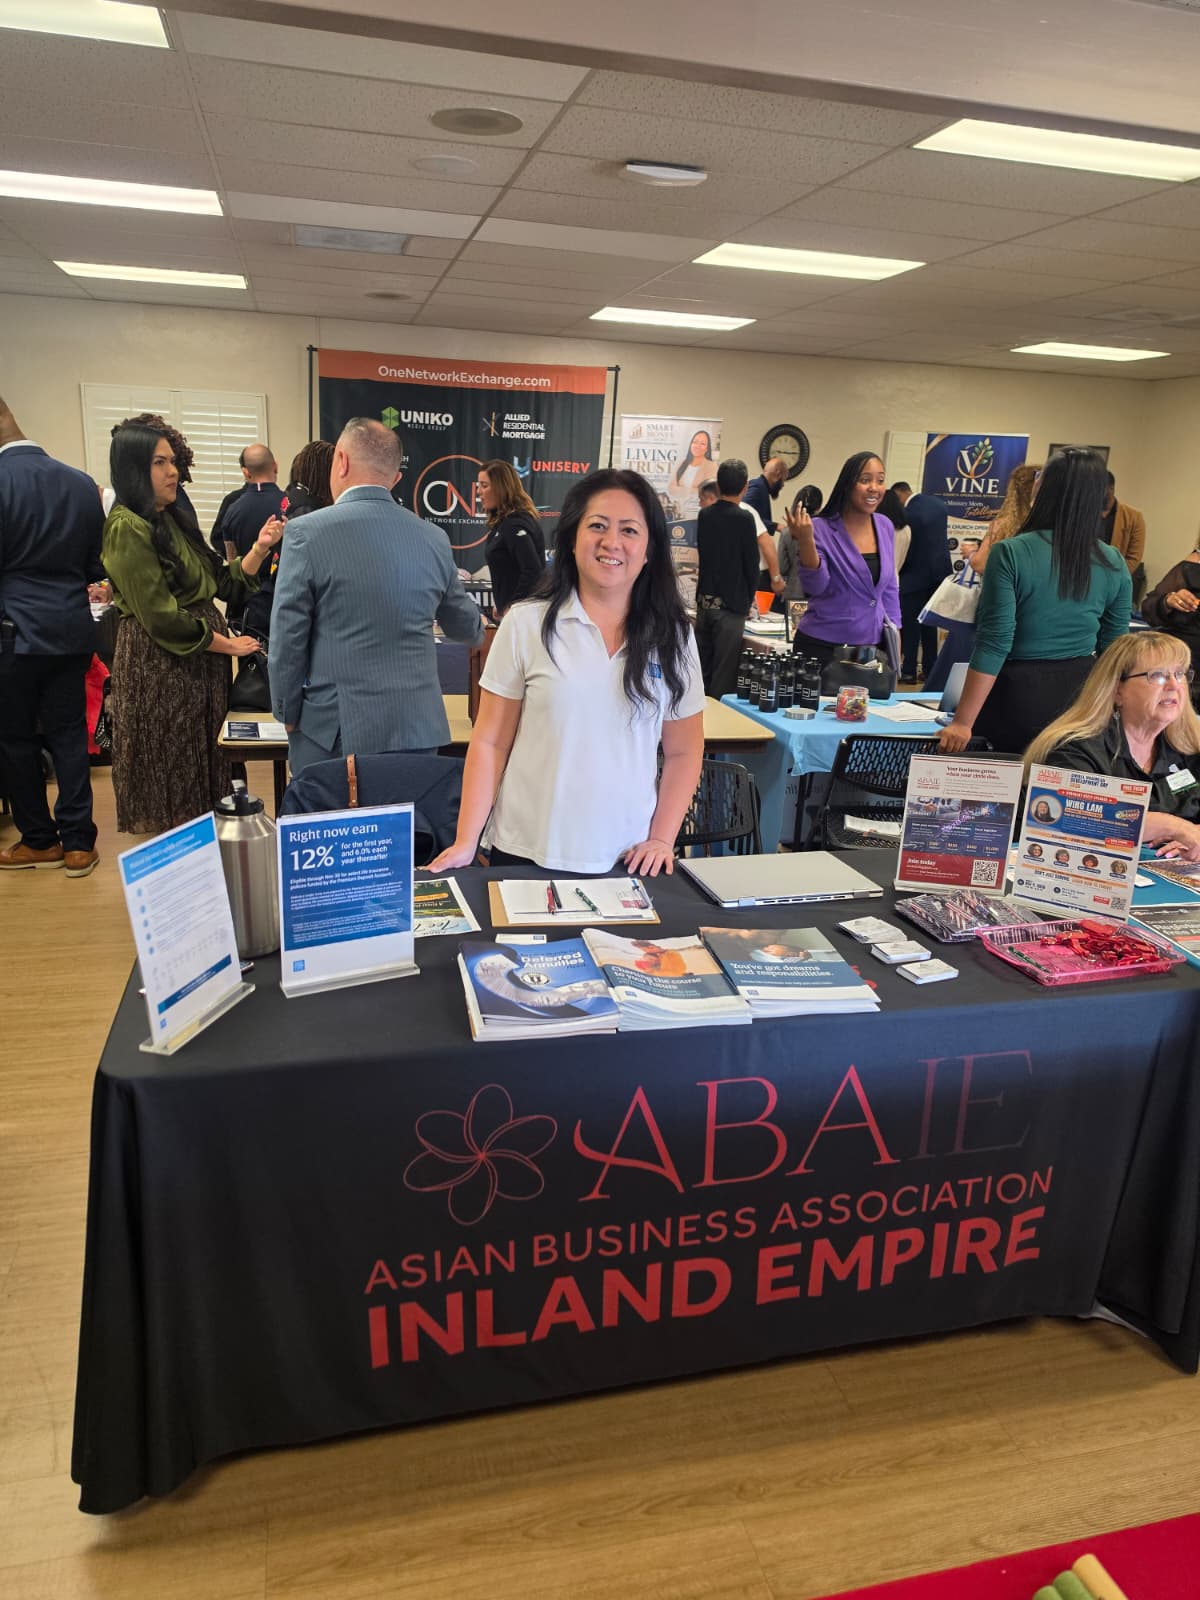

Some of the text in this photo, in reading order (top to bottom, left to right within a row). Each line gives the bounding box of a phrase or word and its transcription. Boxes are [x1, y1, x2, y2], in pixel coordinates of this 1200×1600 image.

[378, 365, 551, 387] OneNetworkExchange.com
[400, 410, 453, 426] UNIKO
[504, 413, 530, 421] ALLIED
[503, 422, 546, 431] RESIDENTIAL
[502, 431, 545, 440] MORTGAGE
[626, 448, 678, 461] LIVING
[532, 461, 591, 474] UNISERV
[626, 461, 673, 474] TRUST
[945, 477, 1000, 494] VINE
[1065, 798, 1103, 813] WING LAM
[289, 824, 378, 843] Right now earn
[341, 842, 351, 850] for
[364, 839, 377, 847] first
[290, 845, 334, 871] 12%
[341, 849, 354, 857] and
[354, 847, 371, 856] 6.0%
[341, 857, 355, 866] year
[521, 951, 582, 963] Deferred
[523, 958, 585, 969] Annuities
[729, 962, 762, 970] You've
[764, 963, 781, 971] got
[364, 1166, 1053, 1295] ASIAN BUSINESS ASSOCIATION
[368, 1205, 1046, 1369] INLAND EMPIRE
